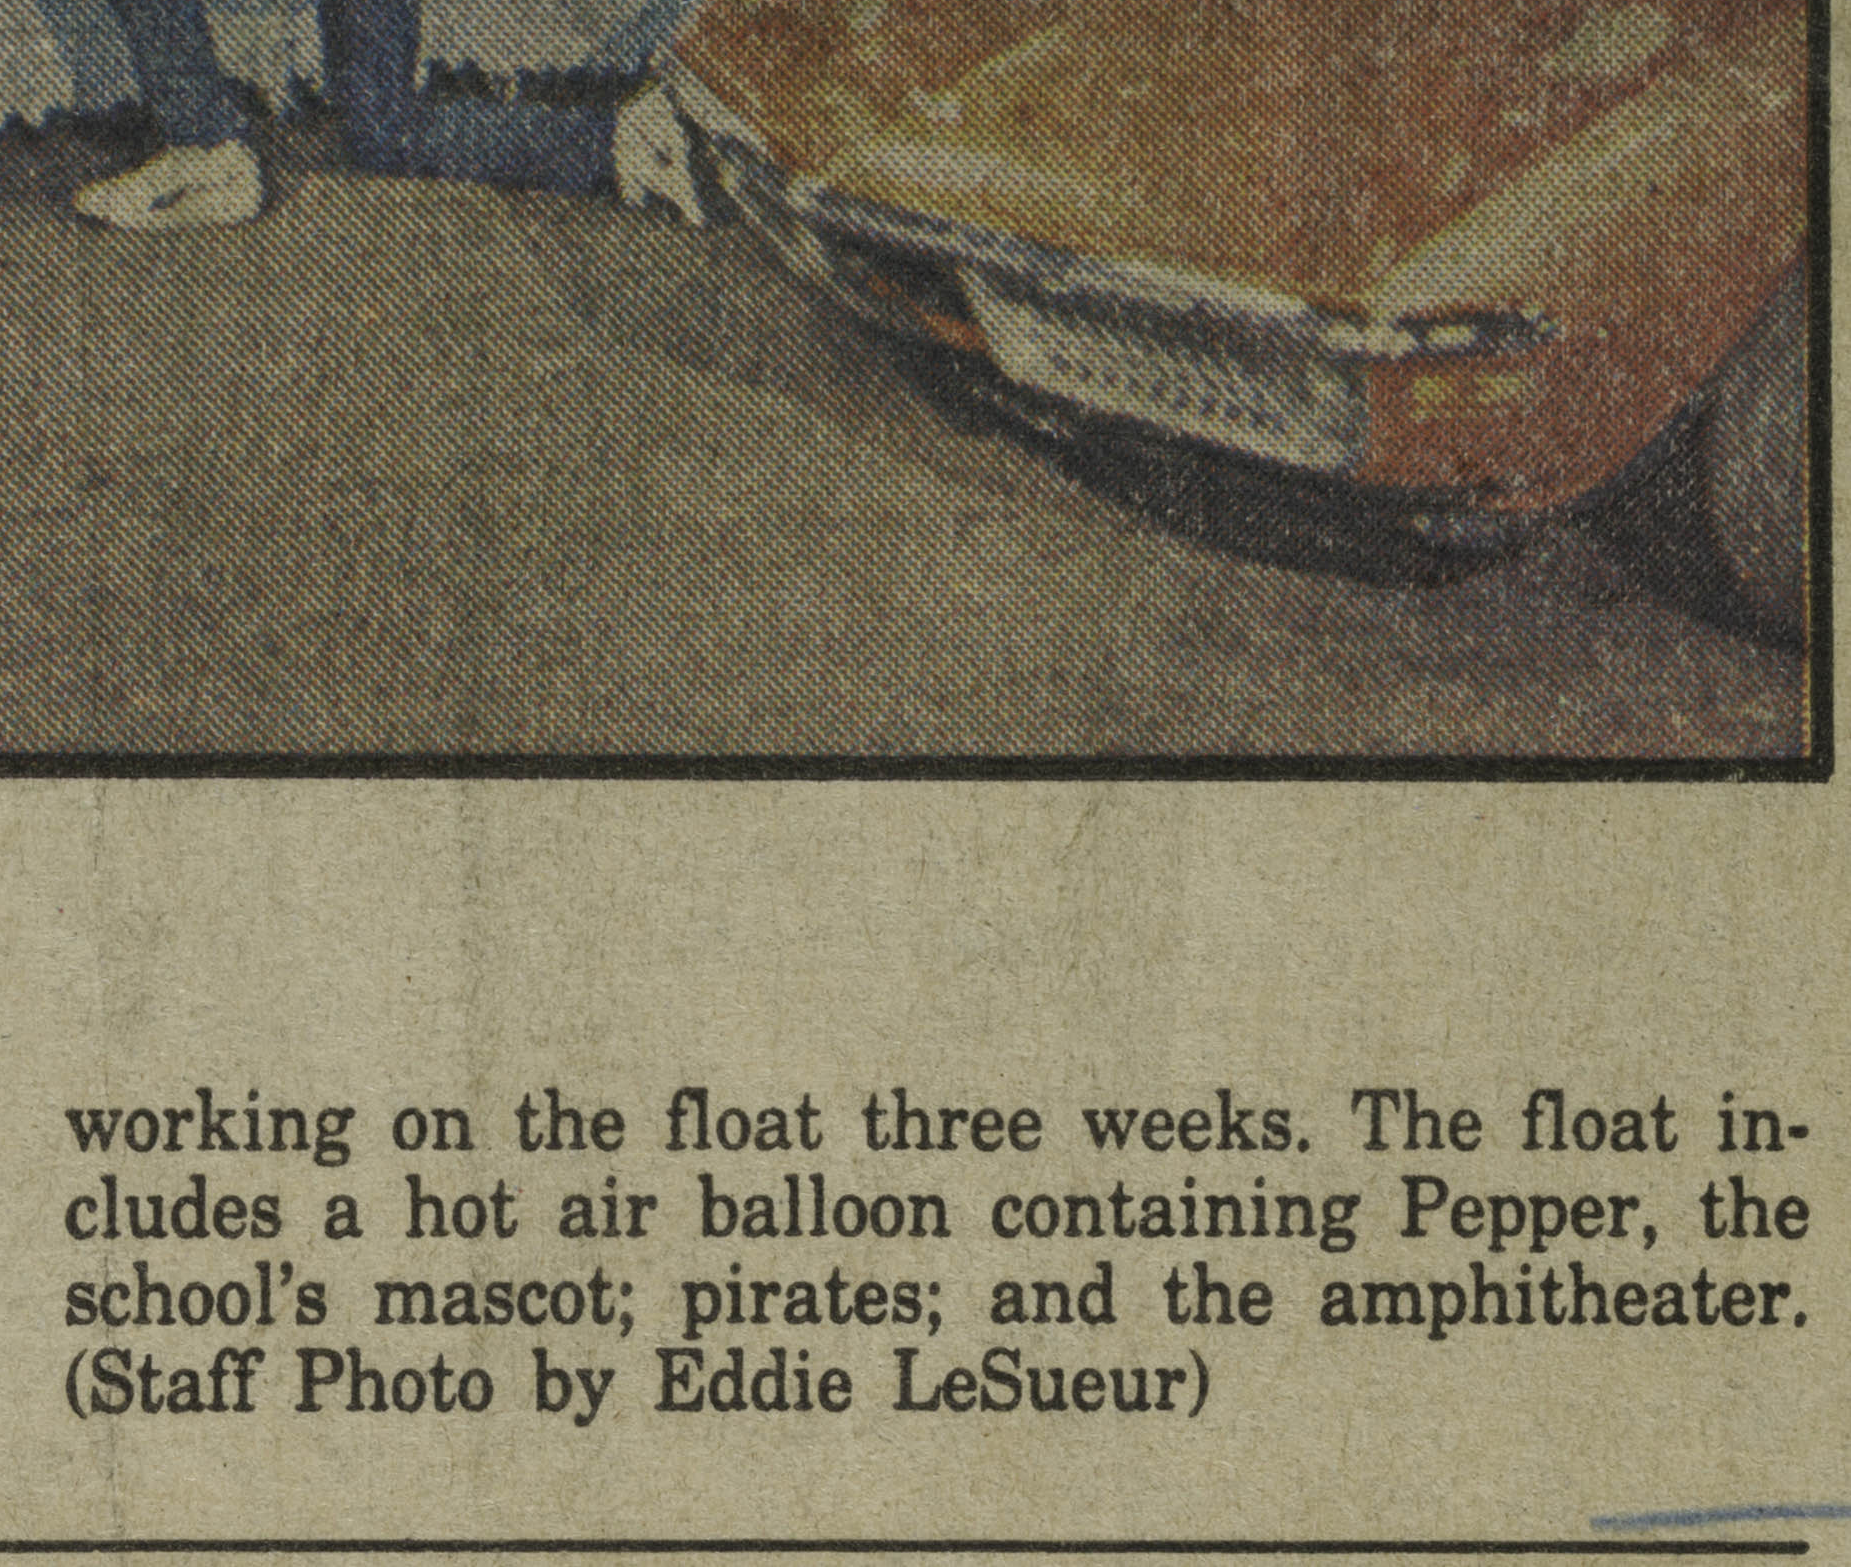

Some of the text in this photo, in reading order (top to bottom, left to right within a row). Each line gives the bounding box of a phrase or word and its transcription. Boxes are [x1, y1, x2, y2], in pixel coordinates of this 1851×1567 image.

[65, 1087, 1809, 1167] working on the float three weeks. The float in-
[65, 1173, 1809, 1253] cludes a hot air balloon containing Pepper, the
[65, 1261, 1807, 1341] school's mascot; pirates; and the amphitheater.
[66, 1347, 1209, 1427] (Staff Photo by Eddie LeSueur)
